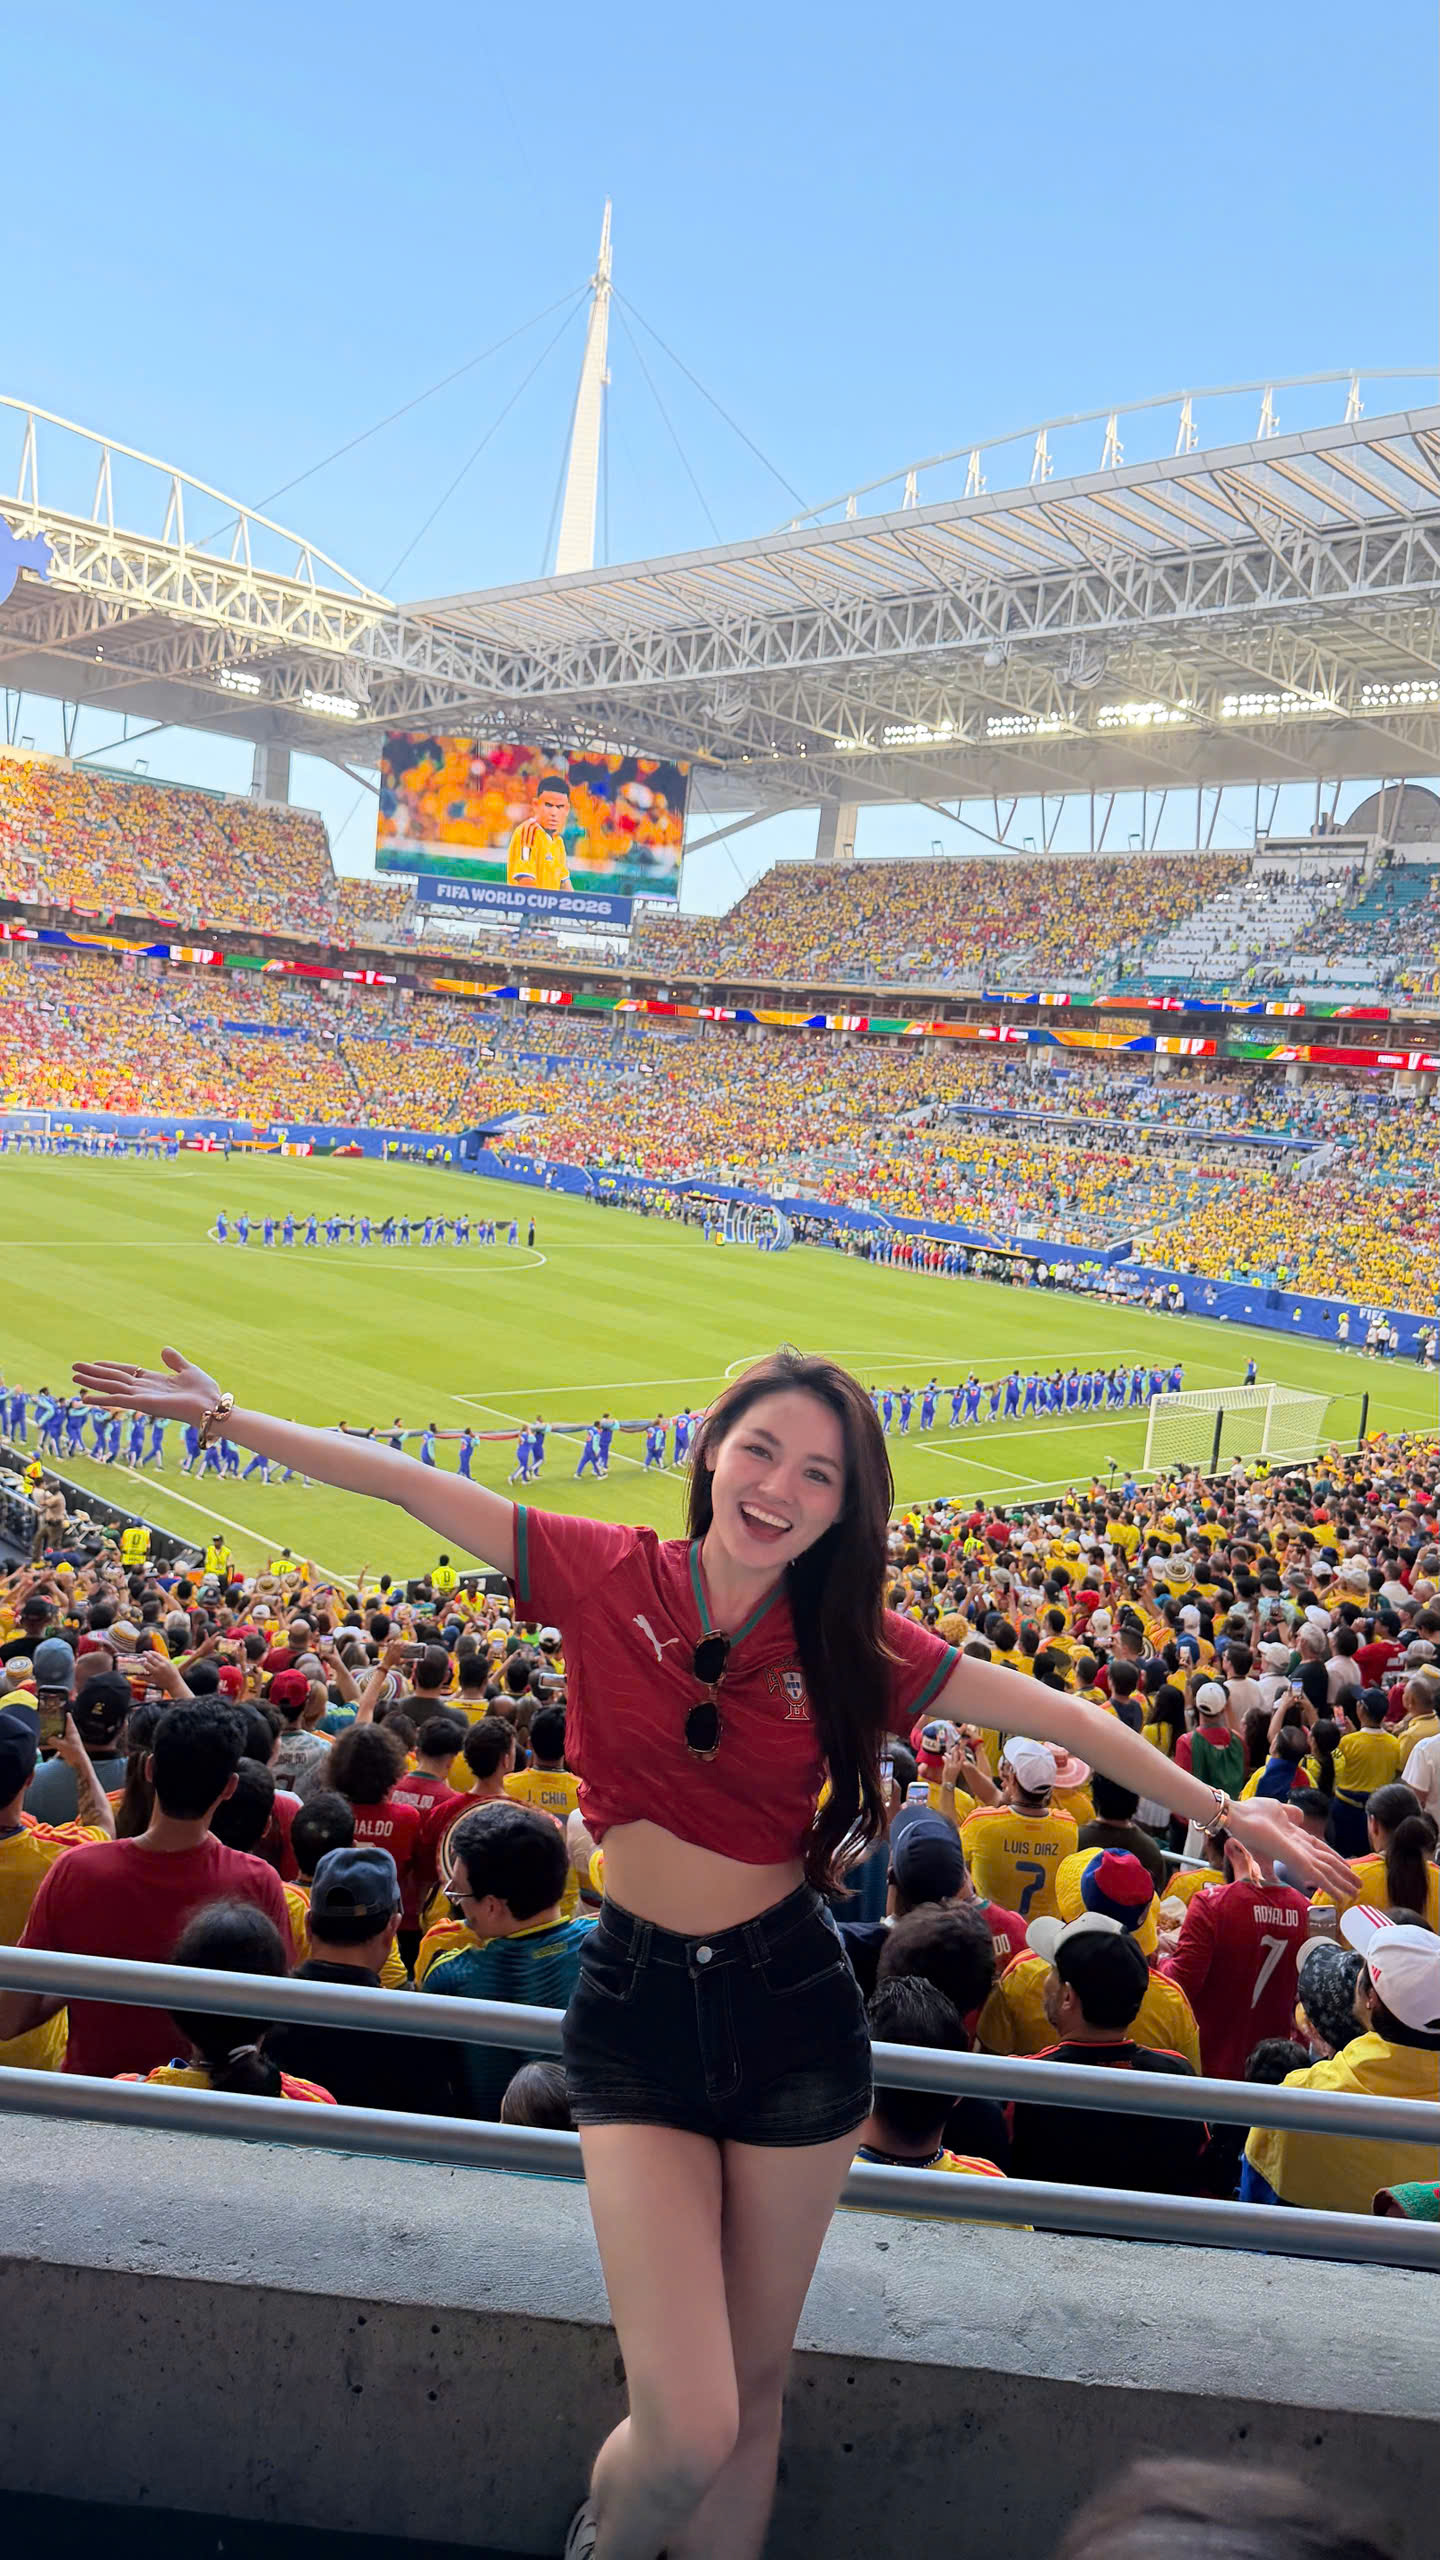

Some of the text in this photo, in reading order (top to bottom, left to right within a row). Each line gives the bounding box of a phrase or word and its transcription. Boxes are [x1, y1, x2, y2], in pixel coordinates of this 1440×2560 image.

[437, 884, 612, 915] FIFA WORLD CUP 2026
[1003, 1839, 1029, 1854] LUIS
[1015, 1860, 1046, 1915] 7
[1250, 1934, 1288, 2009] 7
